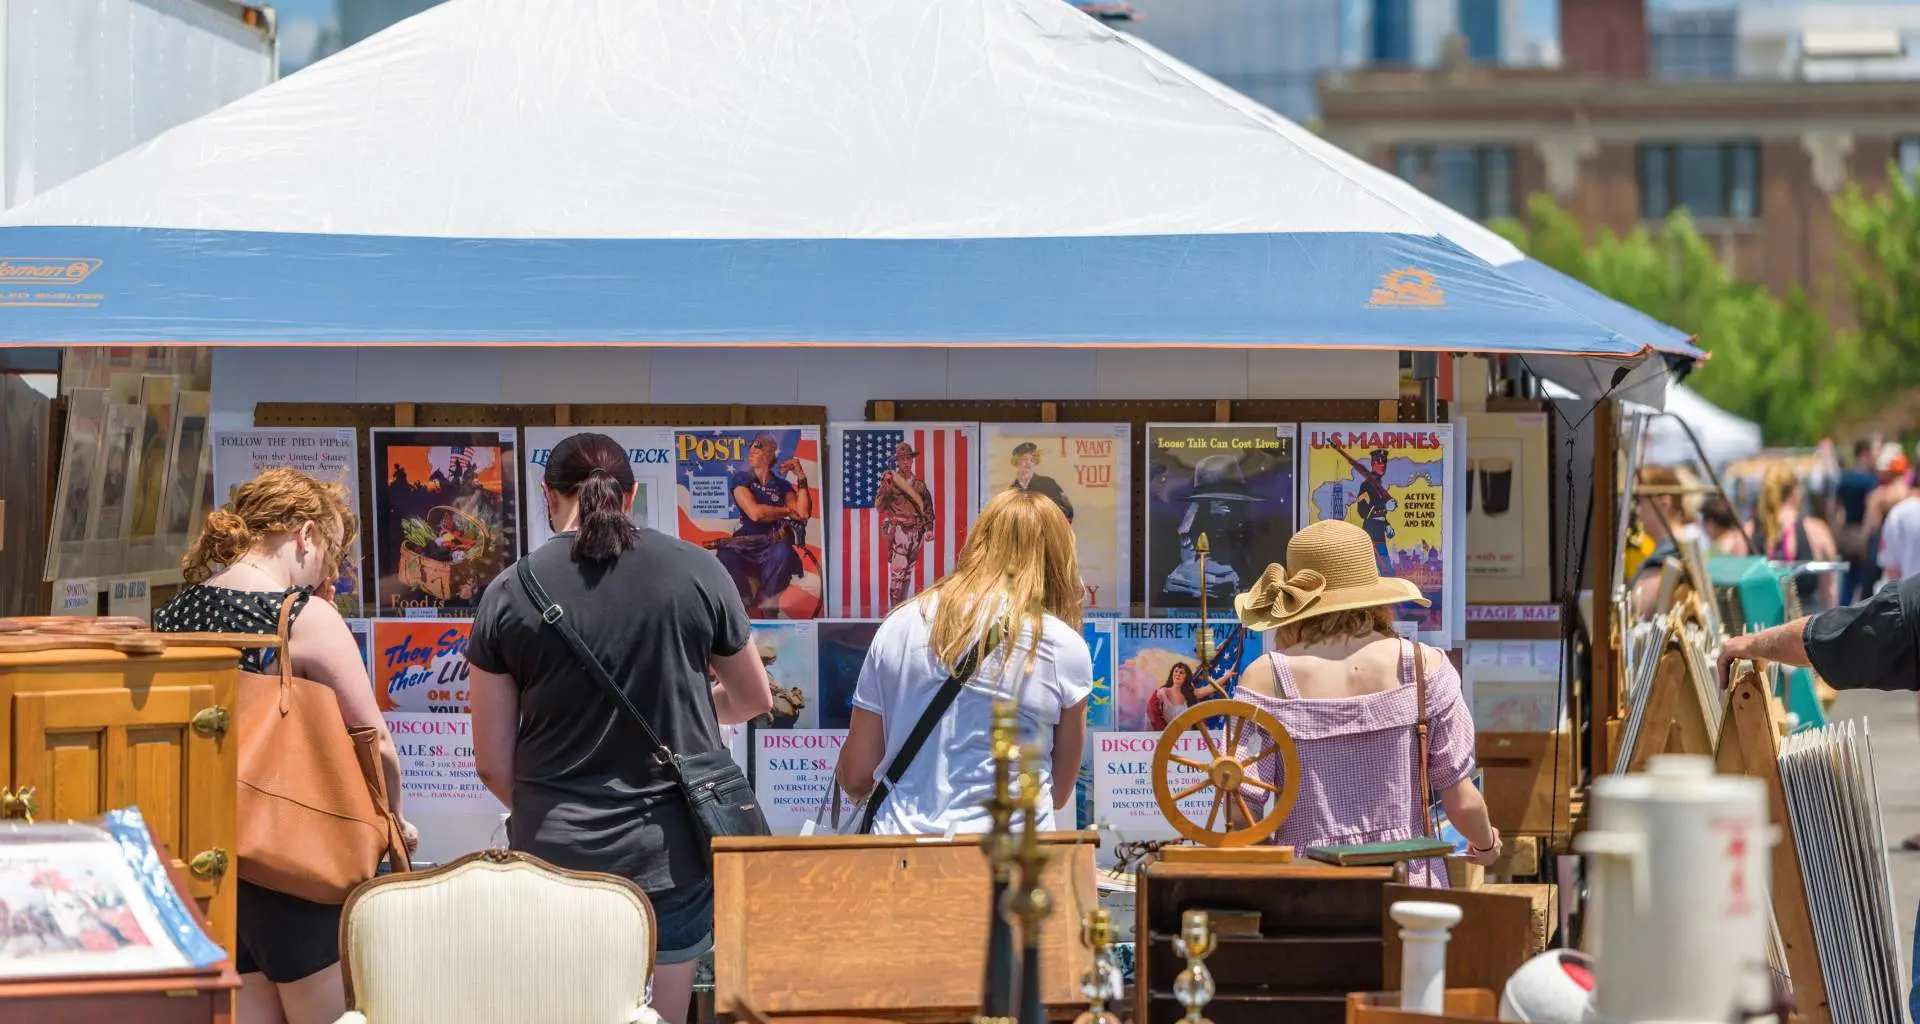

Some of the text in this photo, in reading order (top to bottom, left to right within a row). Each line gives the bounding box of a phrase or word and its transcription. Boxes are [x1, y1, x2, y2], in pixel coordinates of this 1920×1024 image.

[221, 437, 350, 448] FOLLOW THE PIED PIPER
[1158, 438, 1185, 449] Loose
[1187, 438, 1208, 449] Talk
[1209, 438, 1228, 449] Can
[1231, 438, 1252, 449] Cost
[1255, 438, 1280, 449] Lives
[1348, 431, 1441, 449] MARINES
[1059, 436, 1112, 457] I WANT
[252, 451, 348, 462] Join the United States
[319, 462, 341, 473] Army
[1073, 464, 1112, 487] YOU
[1404, 492, 1436, 501] ACTIVE
[1404, 502, 1436, 510] SERVICE
[1404, 511, 1436, 519] ON LAND
[1404, 520, 1436, 528] AND SEA
[391, 594, 445, 609] Food is
[1466, 607, 1556, 619] NTAGE MAP
[1122, 622, 1183, 639] THEATRE
[385, 634, 433, 668] They
[427, 690, 450, 701] ON
[386, 720, 469, 735] DISCOUNT
[396, 744, 427, 756] ALE
[1102, 738, 1192, 752] DISCOT
[769, 758, 809, 770] SALE
[1107, 762, 1148, 775] SALE
[400, 769, 442, 777] VERSTOCK
[460, 784, 488, 792] RETUR
[773, 784, 826, 792] OVERSTOCK
[1112, 801, 1160, 809] DISCONTIN
